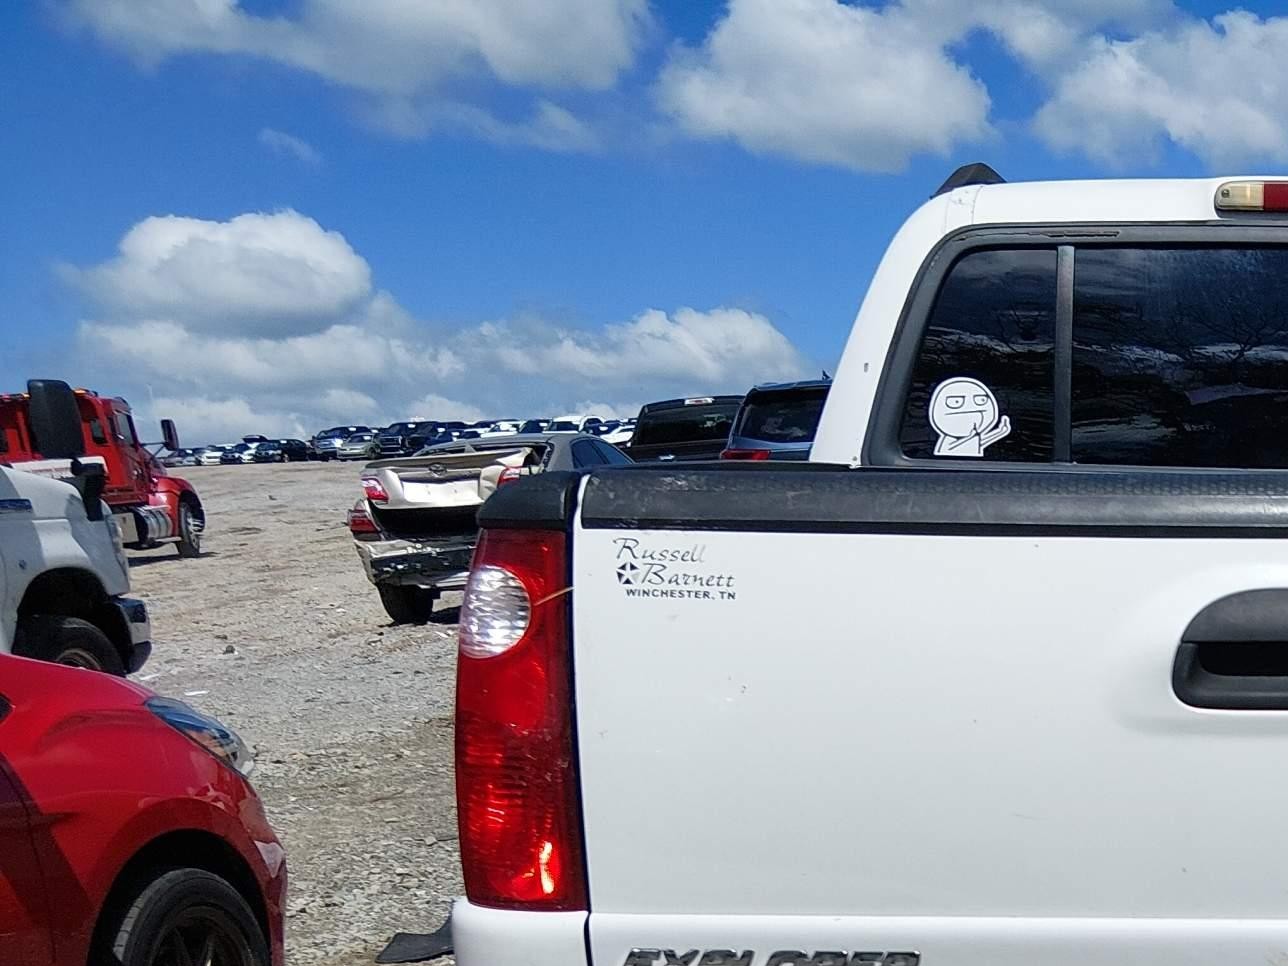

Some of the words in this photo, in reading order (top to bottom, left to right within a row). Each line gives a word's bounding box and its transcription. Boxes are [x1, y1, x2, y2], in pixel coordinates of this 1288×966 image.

[612, 537, 707, 563] Russell
[641, 562, 735, 587] Barnett
[719, 590, 736, 600] TN
